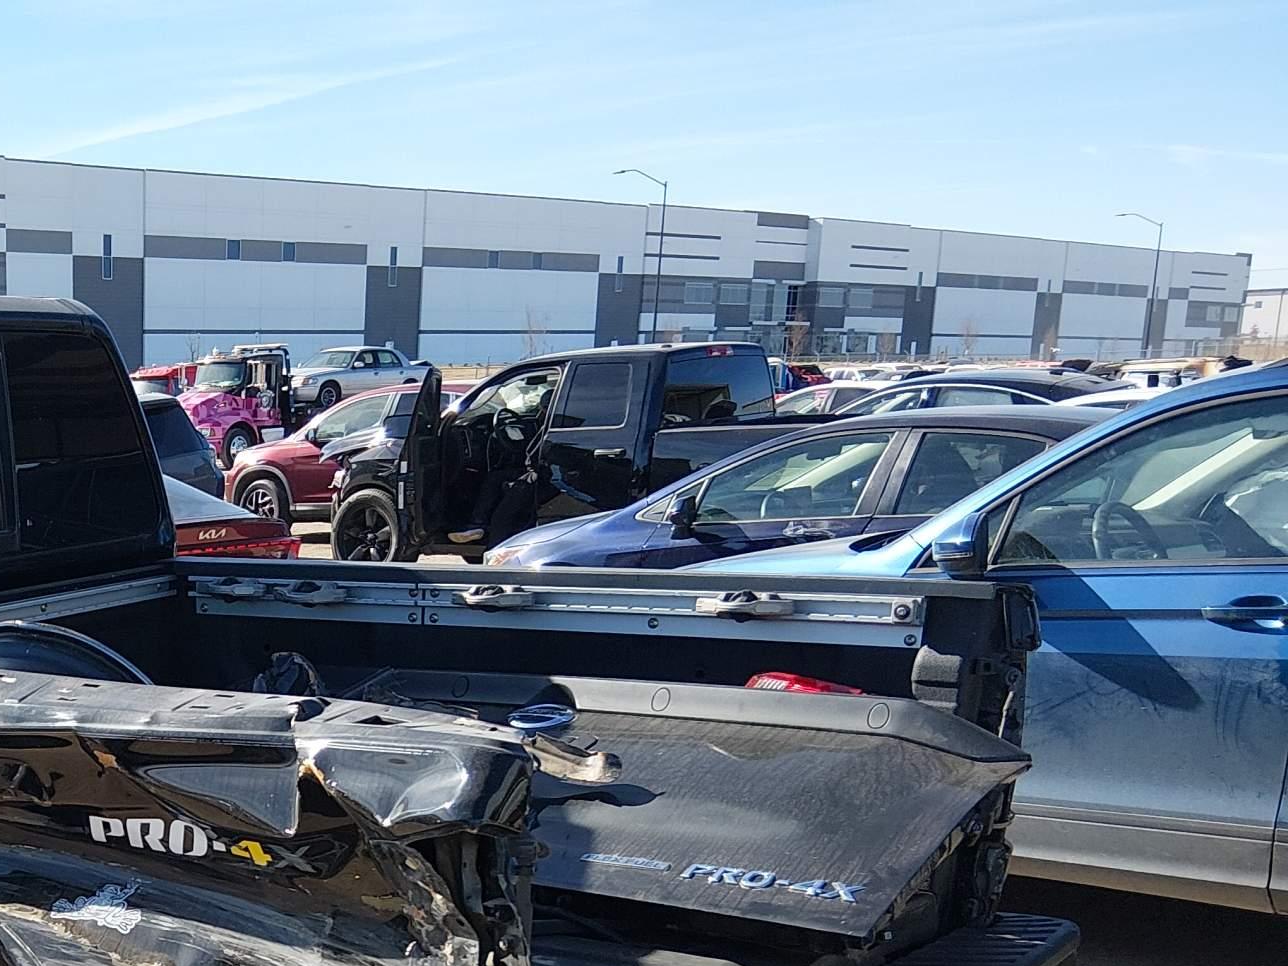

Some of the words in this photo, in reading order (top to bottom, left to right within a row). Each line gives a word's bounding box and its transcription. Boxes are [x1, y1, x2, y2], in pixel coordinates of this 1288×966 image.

[198, 528, 227, 541] KIA
[89, 815, 318, 873] PRO-4X
[679, 862, 866, 904] PRO-4X
